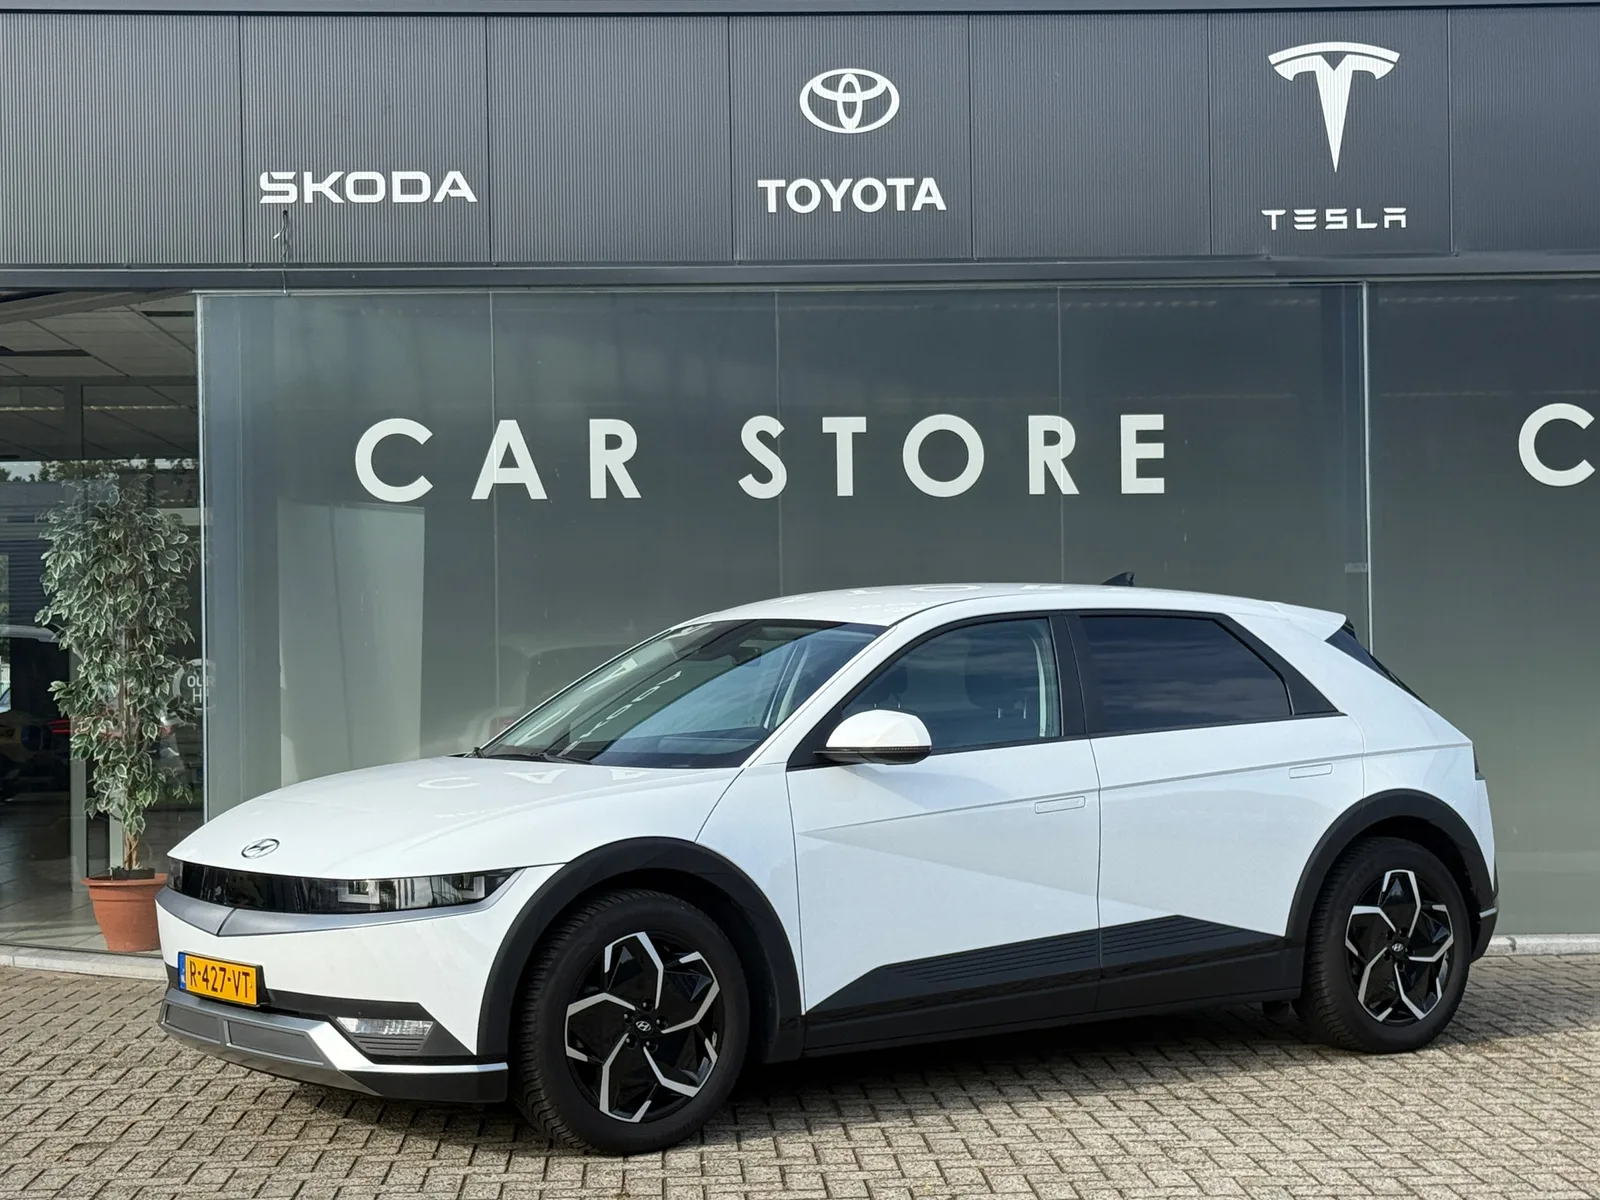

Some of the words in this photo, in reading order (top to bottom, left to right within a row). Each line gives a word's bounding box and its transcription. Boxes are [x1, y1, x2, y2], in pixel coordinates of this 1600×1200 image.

[259, 170, 478, 204] SKODA
[757, 177, 947, 214] TOYOTA
[1261, 207, 1407, 231] TESLA
[355, 417, 642, 502] CAR
[738, 413, 1165, 499] STORE
[1518, 402, 1596, 487] C
